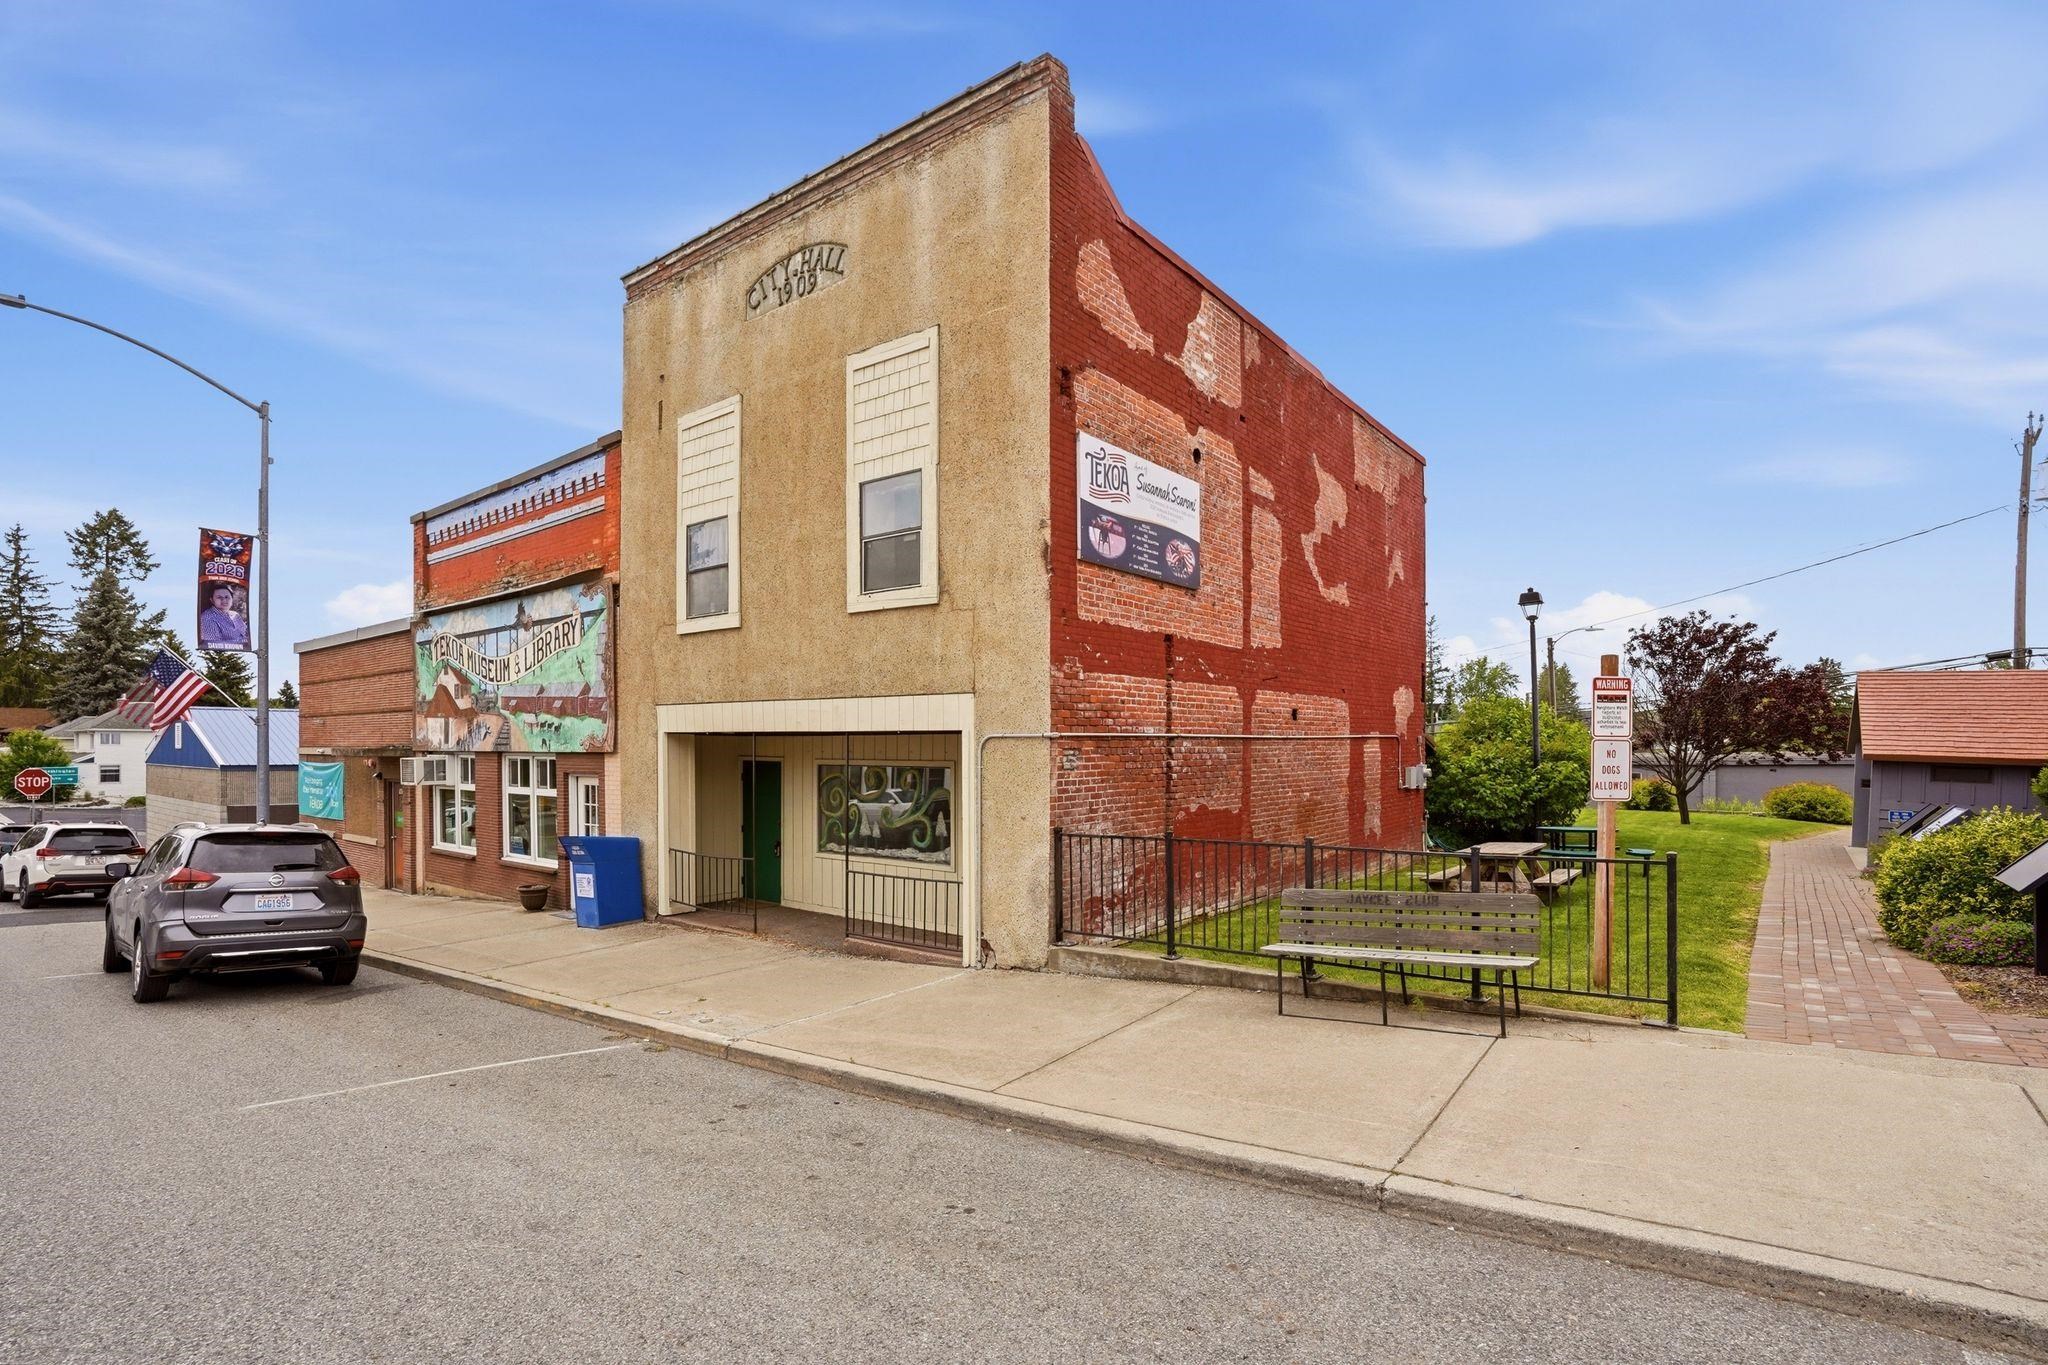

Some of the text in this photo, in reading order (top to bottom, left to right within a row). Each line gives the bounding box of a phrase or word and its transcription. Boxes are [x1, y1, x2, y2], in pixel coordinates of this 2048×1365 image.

[749, 246, 845, 309] CITY HALL
[779, 273, 817, 307] 1909
[1085, 447, 1130, 496] TEKOA
[1136, 473, 1171, 502] Susannah
[205, 561, 245, 579] 2026
[434, 617, 578, 683] TEKOA MUSEUM & LIBRARY
[1595, 679, 1628, 690] WARNING
[1606, 750, 1616, 758] NO
[1602, 765, 1620, 774] DOGS
[18, 777, 49, 787] STOP
[1595, 781, 1628, 790] ALLOWED
